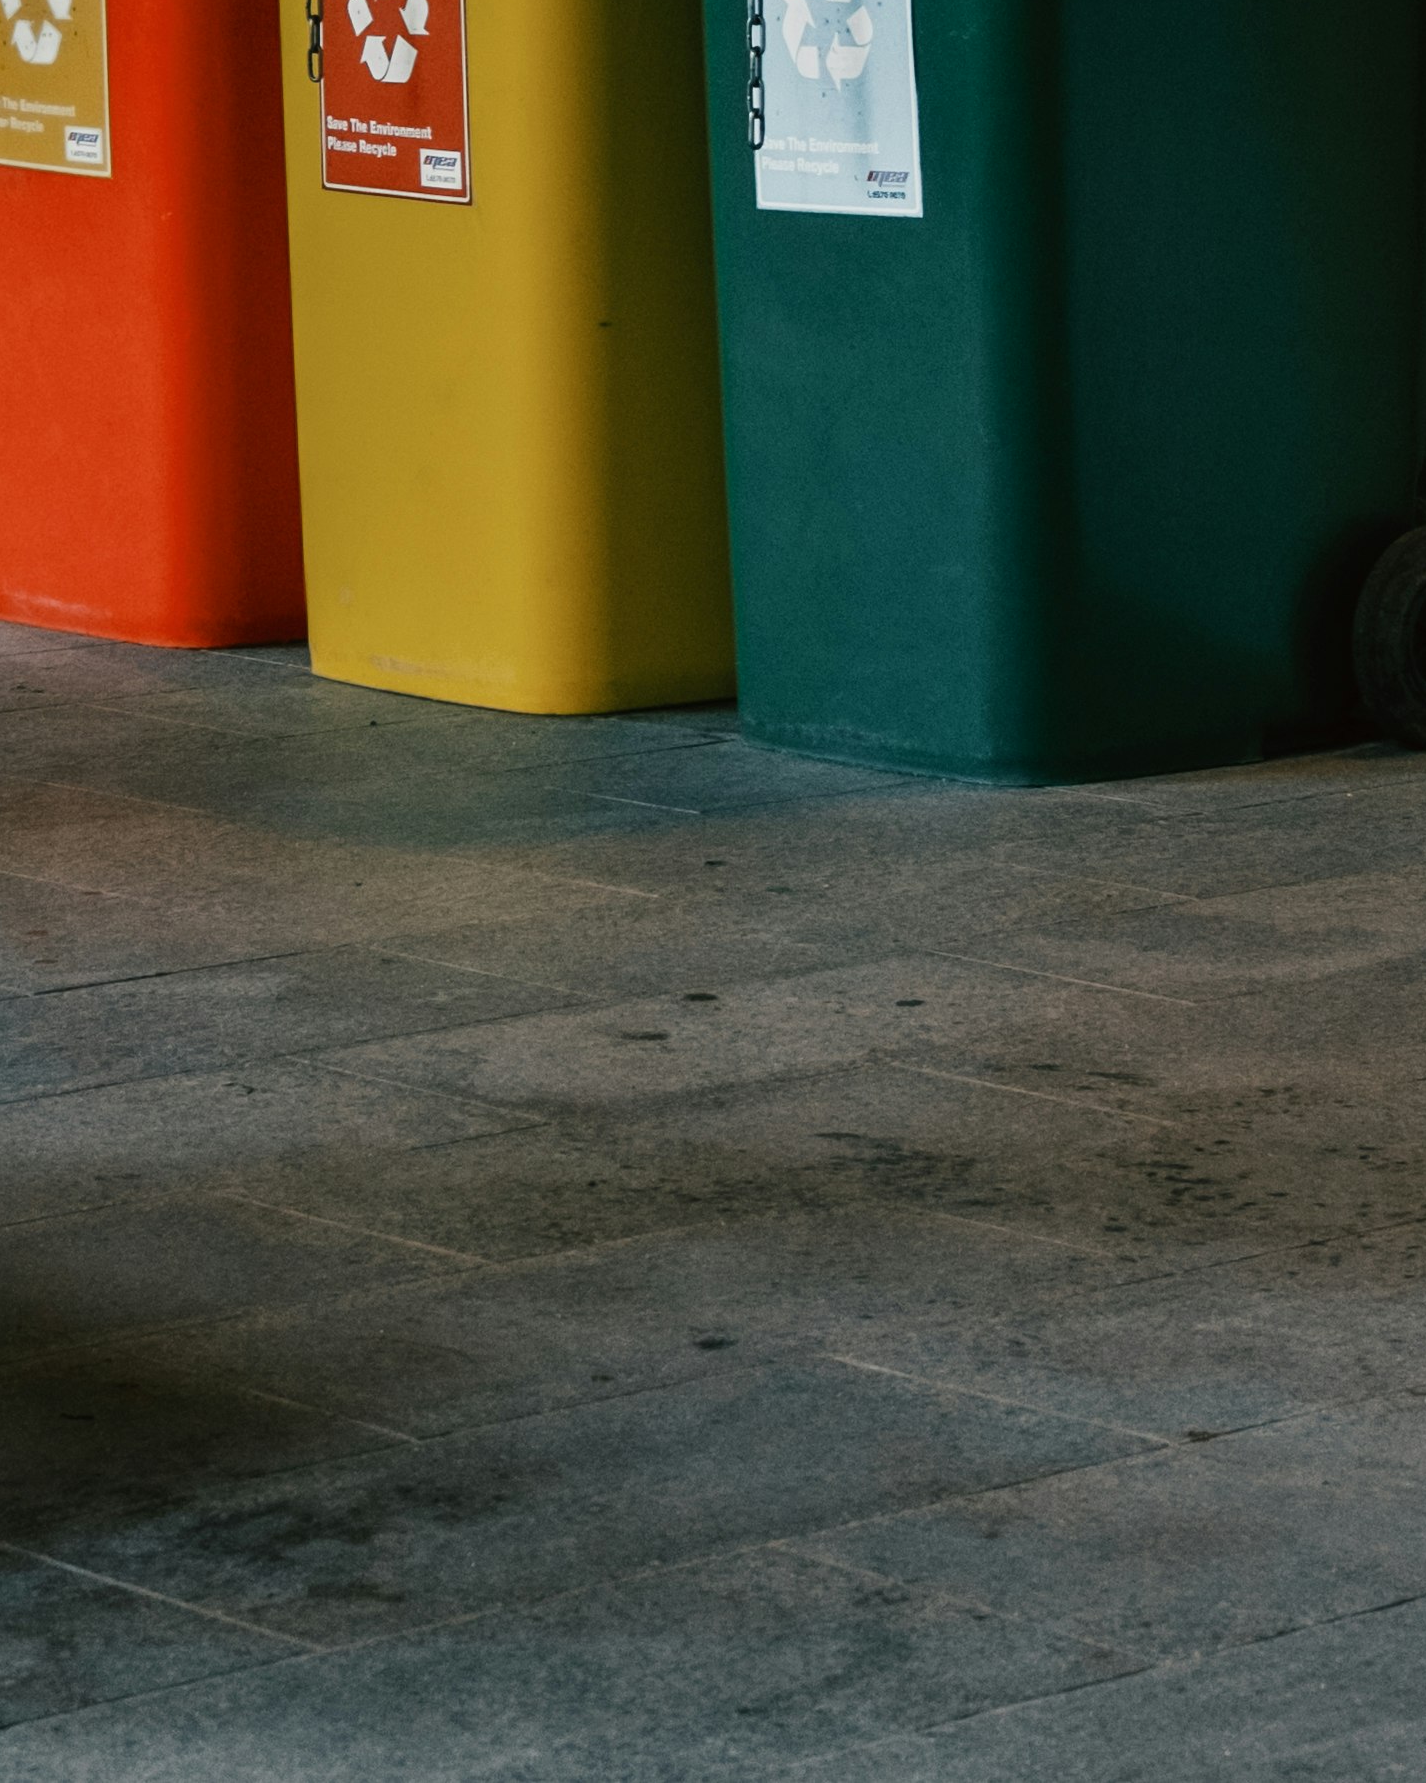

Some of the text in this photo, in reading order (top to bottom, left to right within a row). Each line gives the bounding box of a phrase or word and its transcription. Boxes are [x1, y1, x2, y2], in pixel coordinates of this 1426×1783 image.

[2, 96, 18, 110] The
[20, 99, 75, 117] Environment
[10, 116, 44, 133] Recycle
[326, 115, 432, 140] Save The Environment
[327, 136, 397, 158] Please Recycle
[787, 136, 806, 152] The
[809, 137, 879, 154] Environment
[762, 156, 839, 176] Please Recycle
